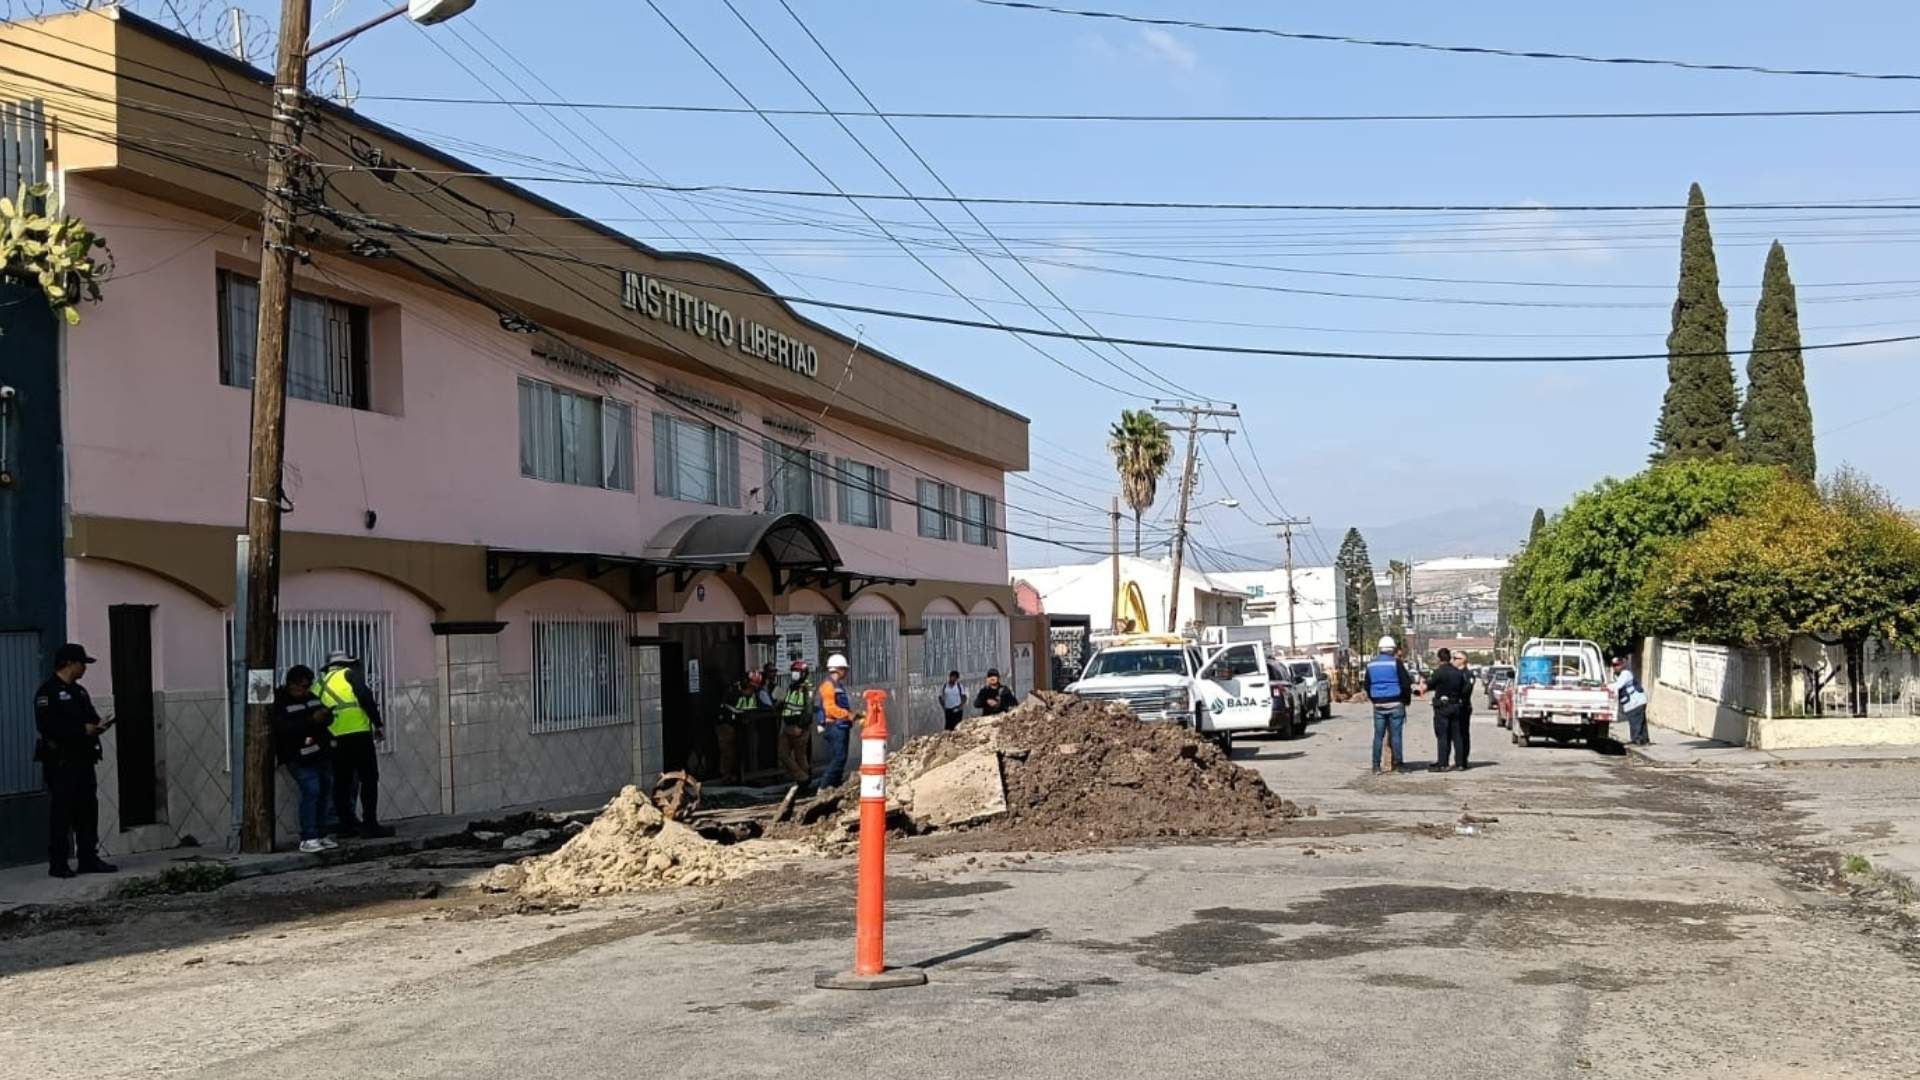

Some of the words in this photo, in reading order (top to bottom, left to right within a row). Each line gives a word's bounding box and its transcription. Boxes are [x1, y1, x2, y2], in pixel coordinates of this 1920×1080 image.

[623, 271, 734, 347] INSTITUTO
[740, 318, 818, 377] LIBERTAD
[1227, 697, 1257, 707] BAJA
